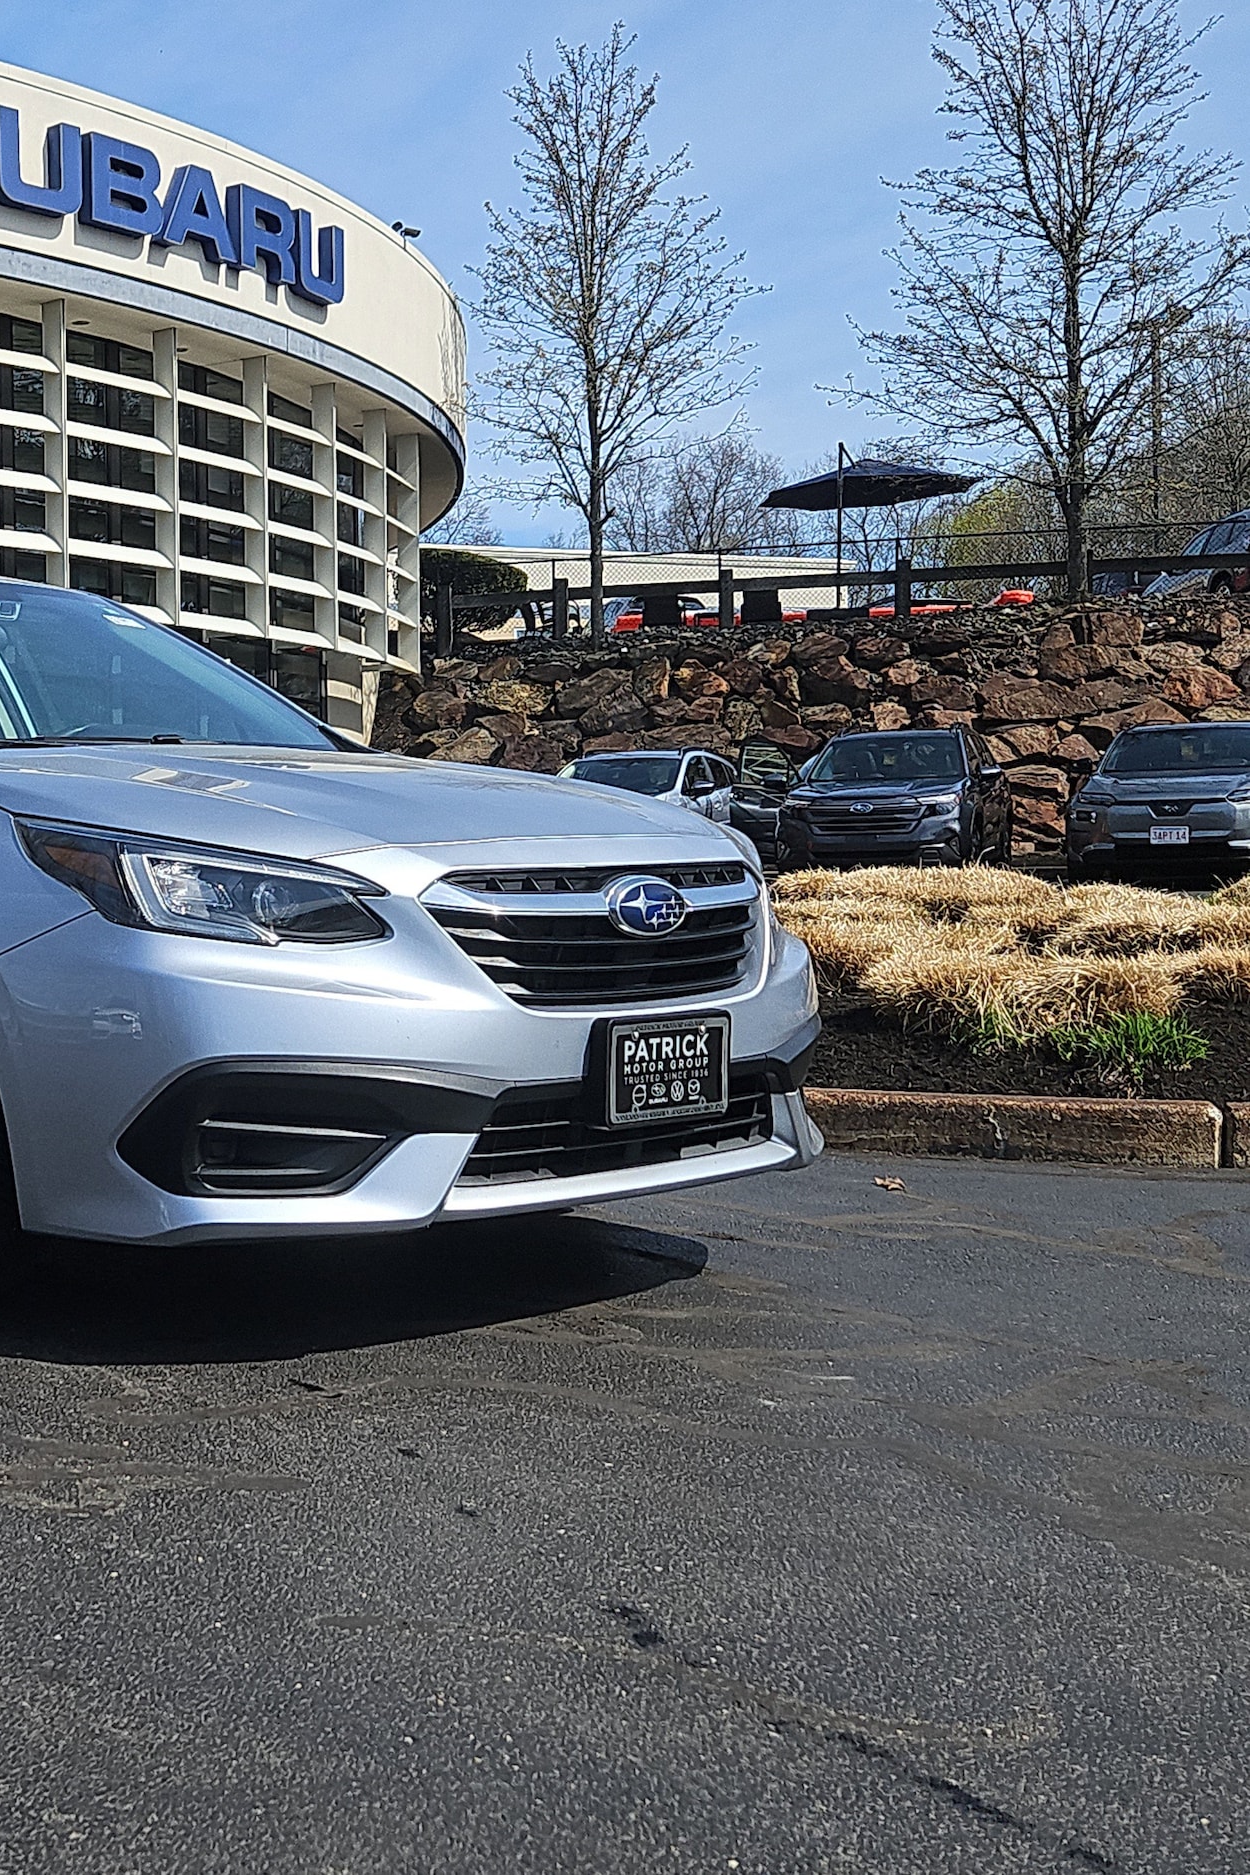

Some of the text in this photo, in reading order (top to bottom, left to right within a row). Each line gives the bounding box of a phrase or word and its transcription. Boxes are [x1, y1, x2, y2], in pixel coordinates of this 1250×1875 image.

[623, 1033, 710, 1063] PATRICK
[624, 1056, 709, 1075] MOTOR GROUP
[624, 1073, 660, 1085] TRUSTED
[663, 1070, 688, 1081] SINCE
